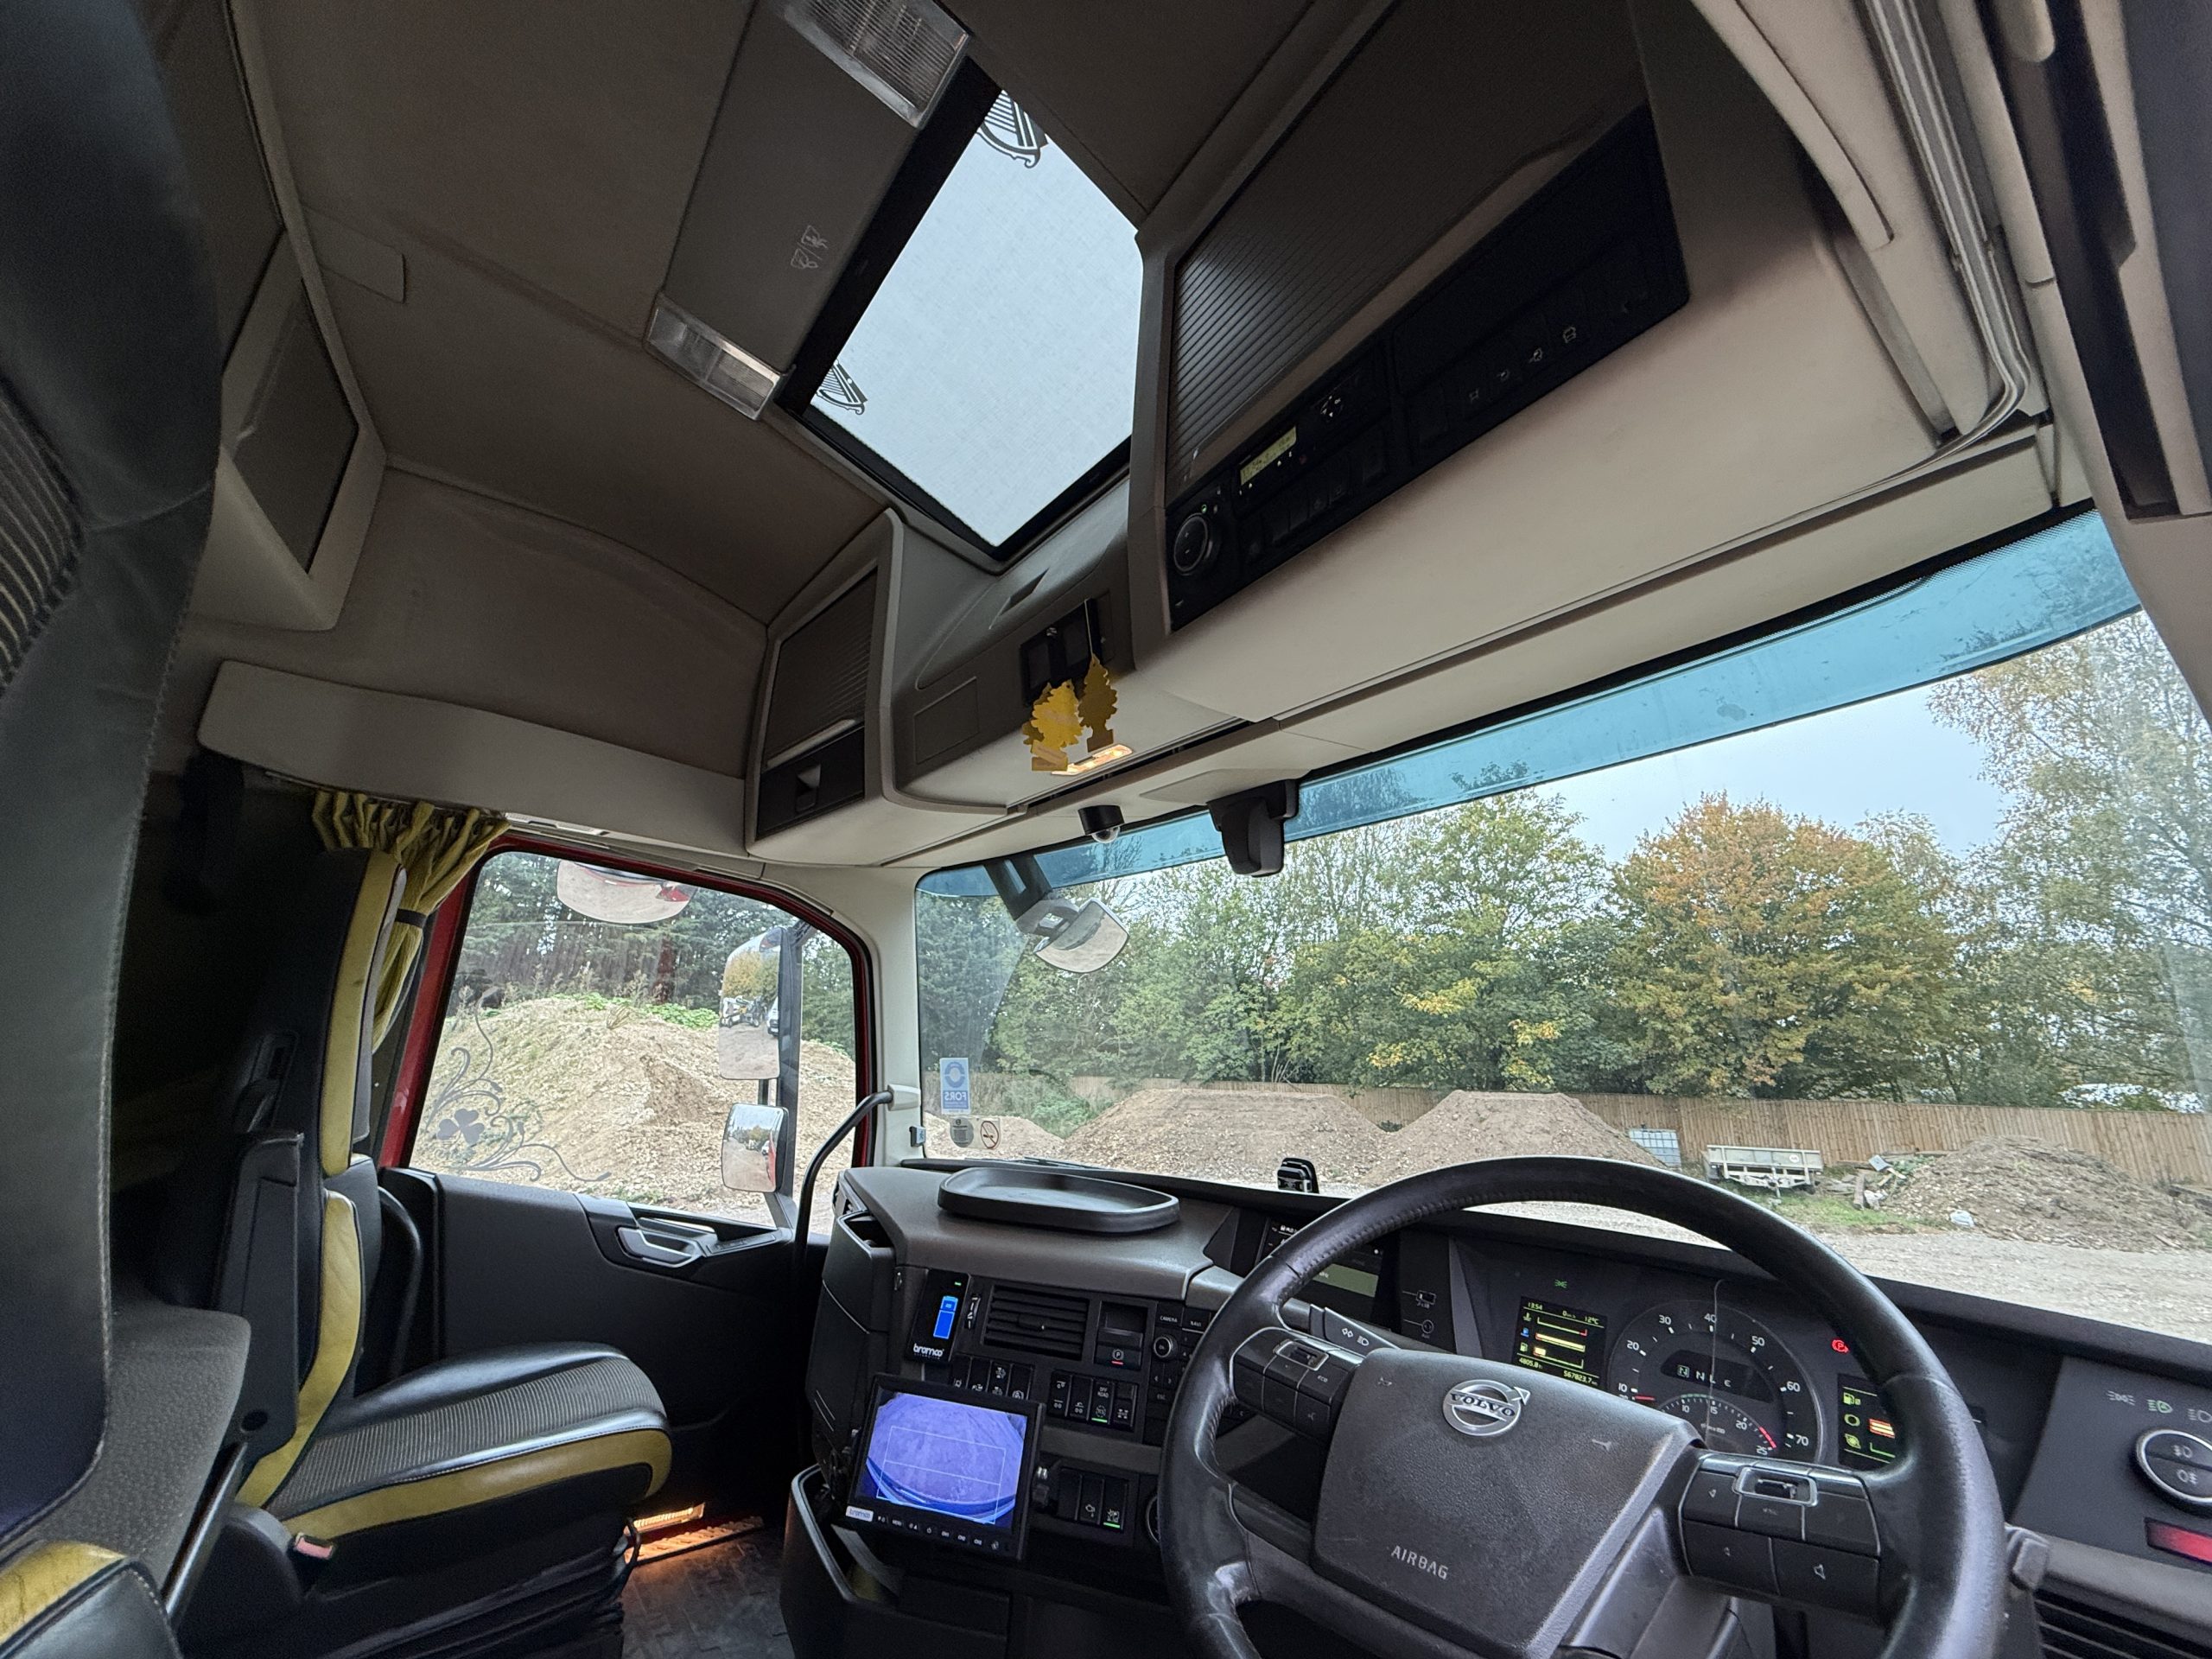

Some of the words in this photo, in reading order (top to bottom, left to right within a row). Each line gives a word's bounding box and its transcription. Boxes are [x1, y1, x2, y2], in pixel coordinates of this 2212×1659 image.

[1658, 1314, 1672, 1325] 30
[1703, 1313, 1717, 1324] 40
[1626, 1339, 1640, 1351] 20
[1751, 1335, 1765, 1347] 50
[1695, 1370, 1706, 1382] N
[1618, 1382, 1628, 1393] 10
[1786, 1381, 1801, 1392] 60
[1449, 1391, 1516, 1418] VOLVO
[1681, 1404, 1690, 1414] 10
[1710, 1406, 1719, 1414] 15
[1735, 1421, 1747, 1431] 20
[1796, 1434, 1809, 1446] 70
[1756, 1446, 1768, 1456] 25
[1390, 1545, 1449, 1580] AIRBAG
